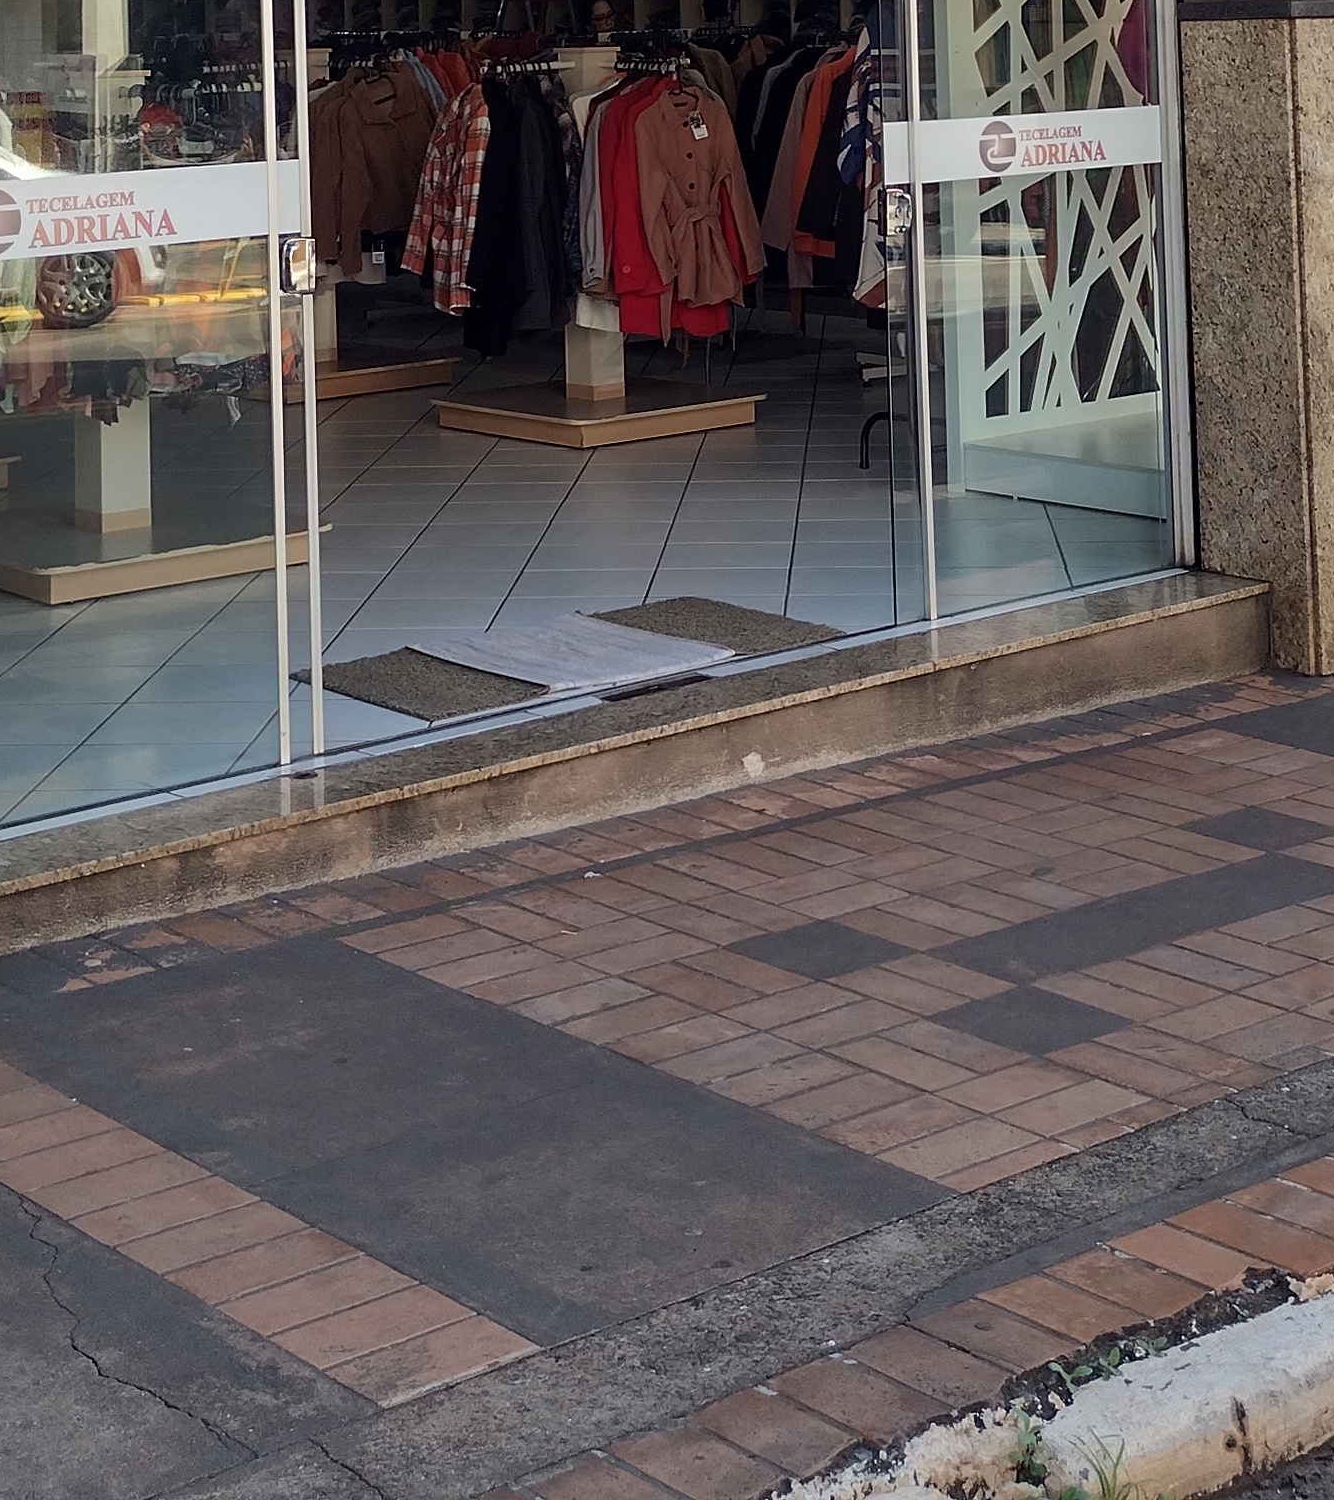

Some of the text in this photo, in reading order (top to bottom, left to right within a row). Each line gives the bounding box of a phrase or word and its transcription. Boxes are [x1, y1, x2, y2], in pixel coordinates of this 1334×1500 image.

[1019, 126, 1082, 142] TECELAGEM
[1020, 139, 1107, 168] ADRIANA
[26, 191, 135, 215] TECELAGEM
[28, 208, 177, 249] ADRIANA
